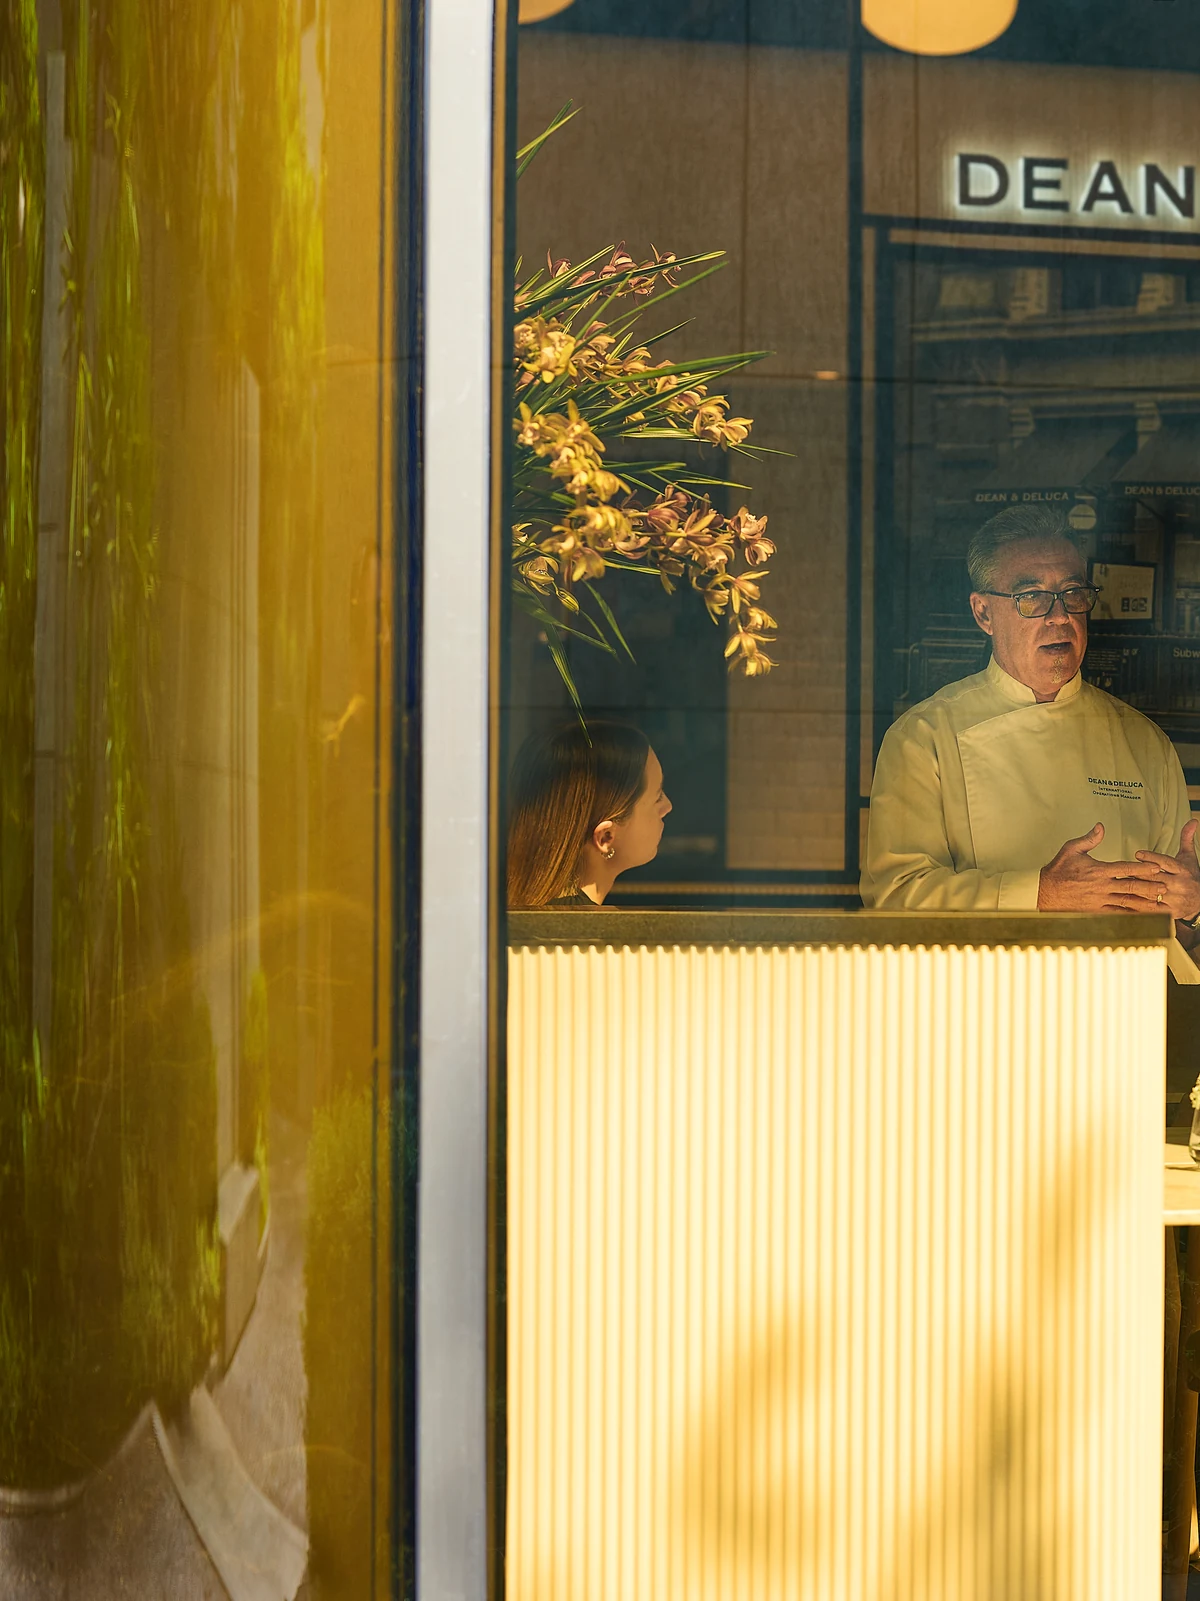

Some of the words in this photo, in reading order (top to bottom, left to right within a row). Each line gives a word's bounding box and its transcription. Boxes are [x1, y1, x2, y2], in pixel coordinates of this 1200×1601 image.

[957, 153, 1196, 218] DEAN
[1124, 486, 1154, 495] DEAN
[975, 493, 1007, 502] DEAN
[1022, 491, 1069, 501] DELUCA
